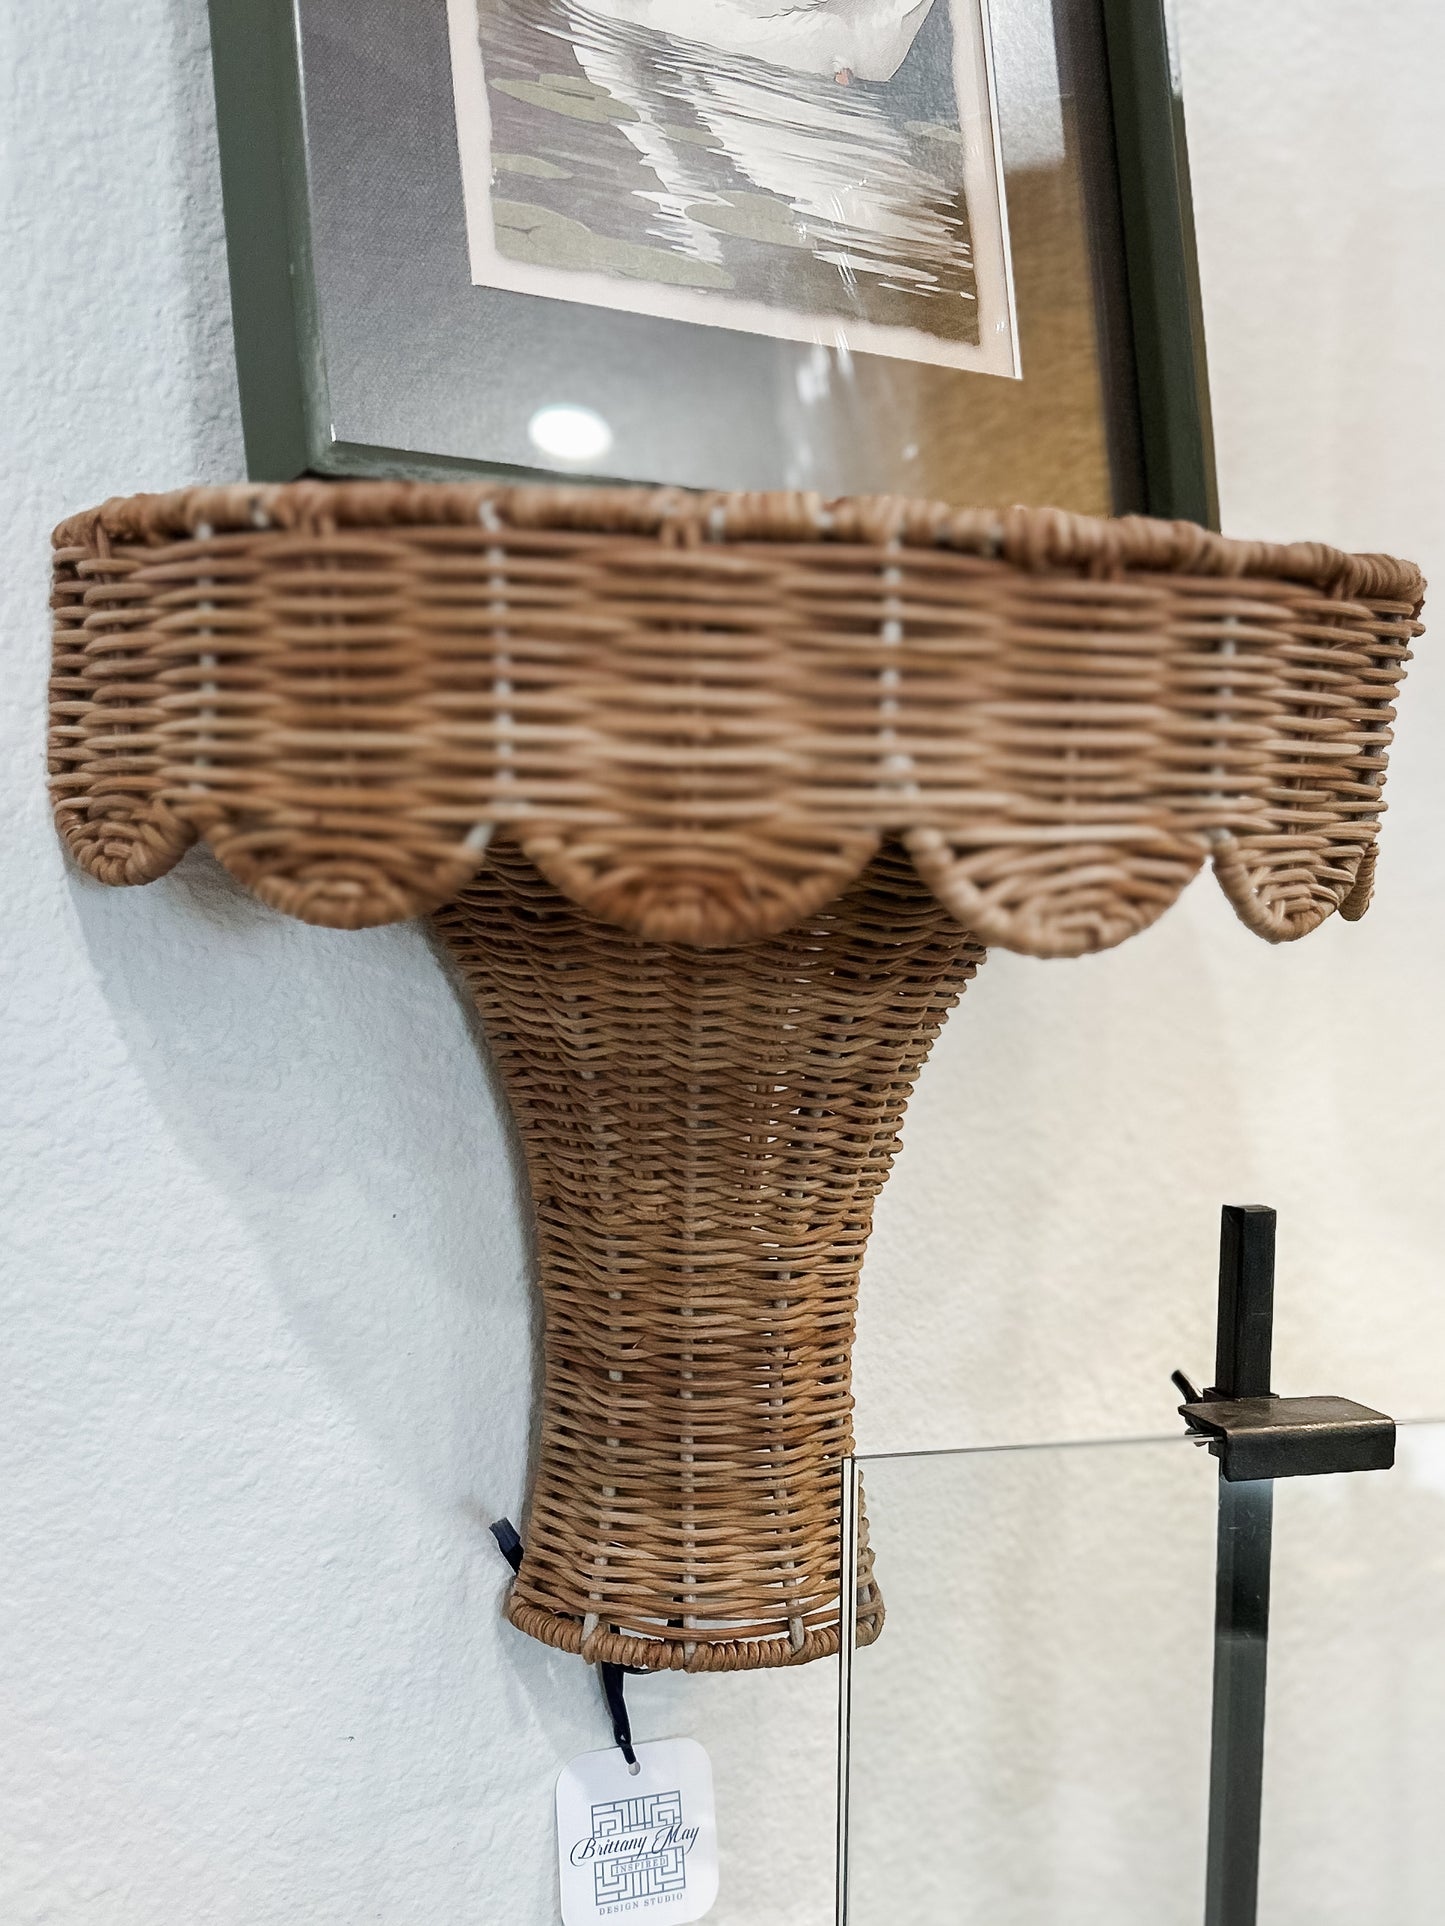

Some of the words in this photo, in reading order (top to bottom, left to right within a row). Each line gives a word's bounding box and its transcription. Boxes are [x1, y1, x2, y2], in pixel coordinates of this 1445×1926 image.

[569, 1836, 648, 1867] Brittany
[651, 1823, 700, 1855] May
[615, 1857, 667, 1874] INSPIRED
[599, 1900, 639, 1916] DESIGN
[643, 1892, 684, 1907] STUDIO
